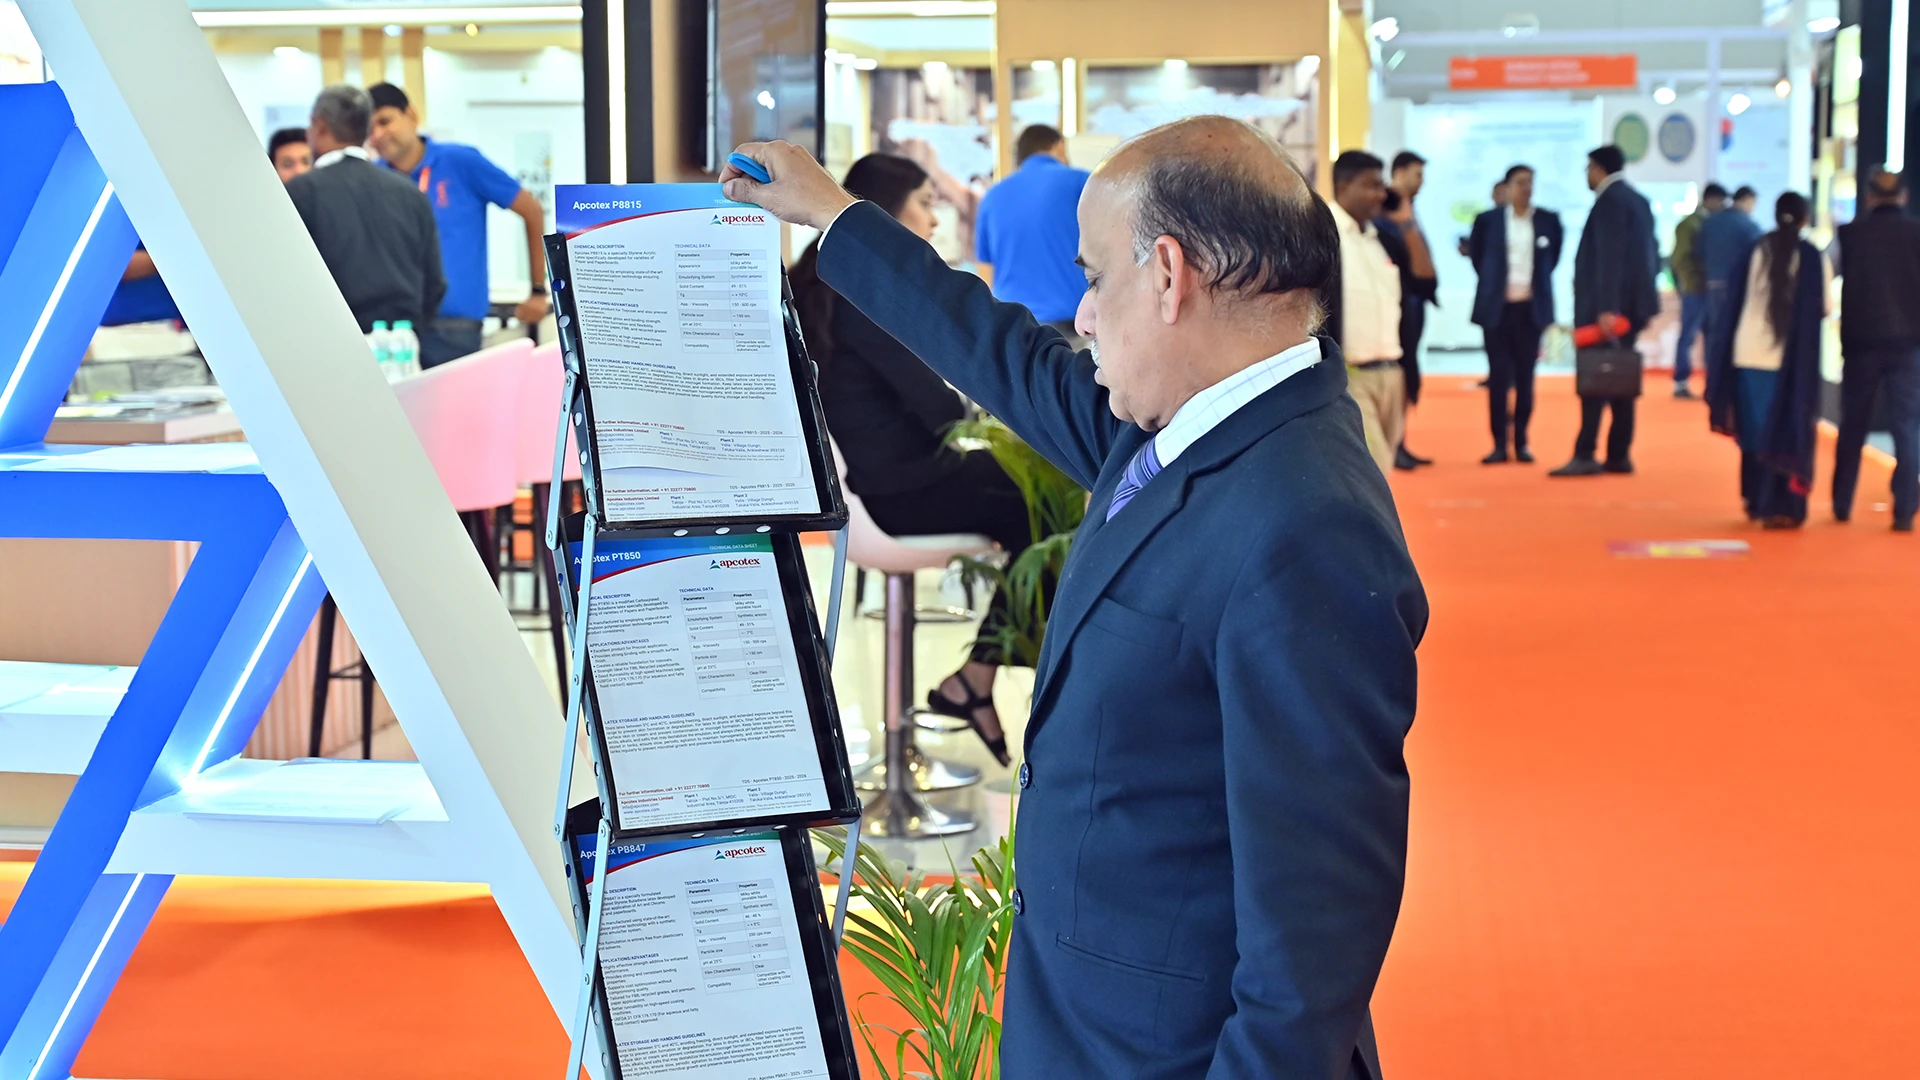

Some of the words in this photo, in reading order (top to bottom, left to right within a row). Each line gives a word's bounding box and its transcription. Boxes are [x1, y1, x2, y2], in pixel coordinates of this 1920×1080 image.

[573, 201, 610, 211] Apcotex
[612, 200, 642, 209] P8815
[722, 214, 764, 224] apcotex
[574, 555, 610, 565] Aotex
[612, 551, 641, 561] PT850
[719, 557, 761, 568] apcotex
[617, 844, 646, 854] PB847
[724, 846, 766, 858] apcotex
